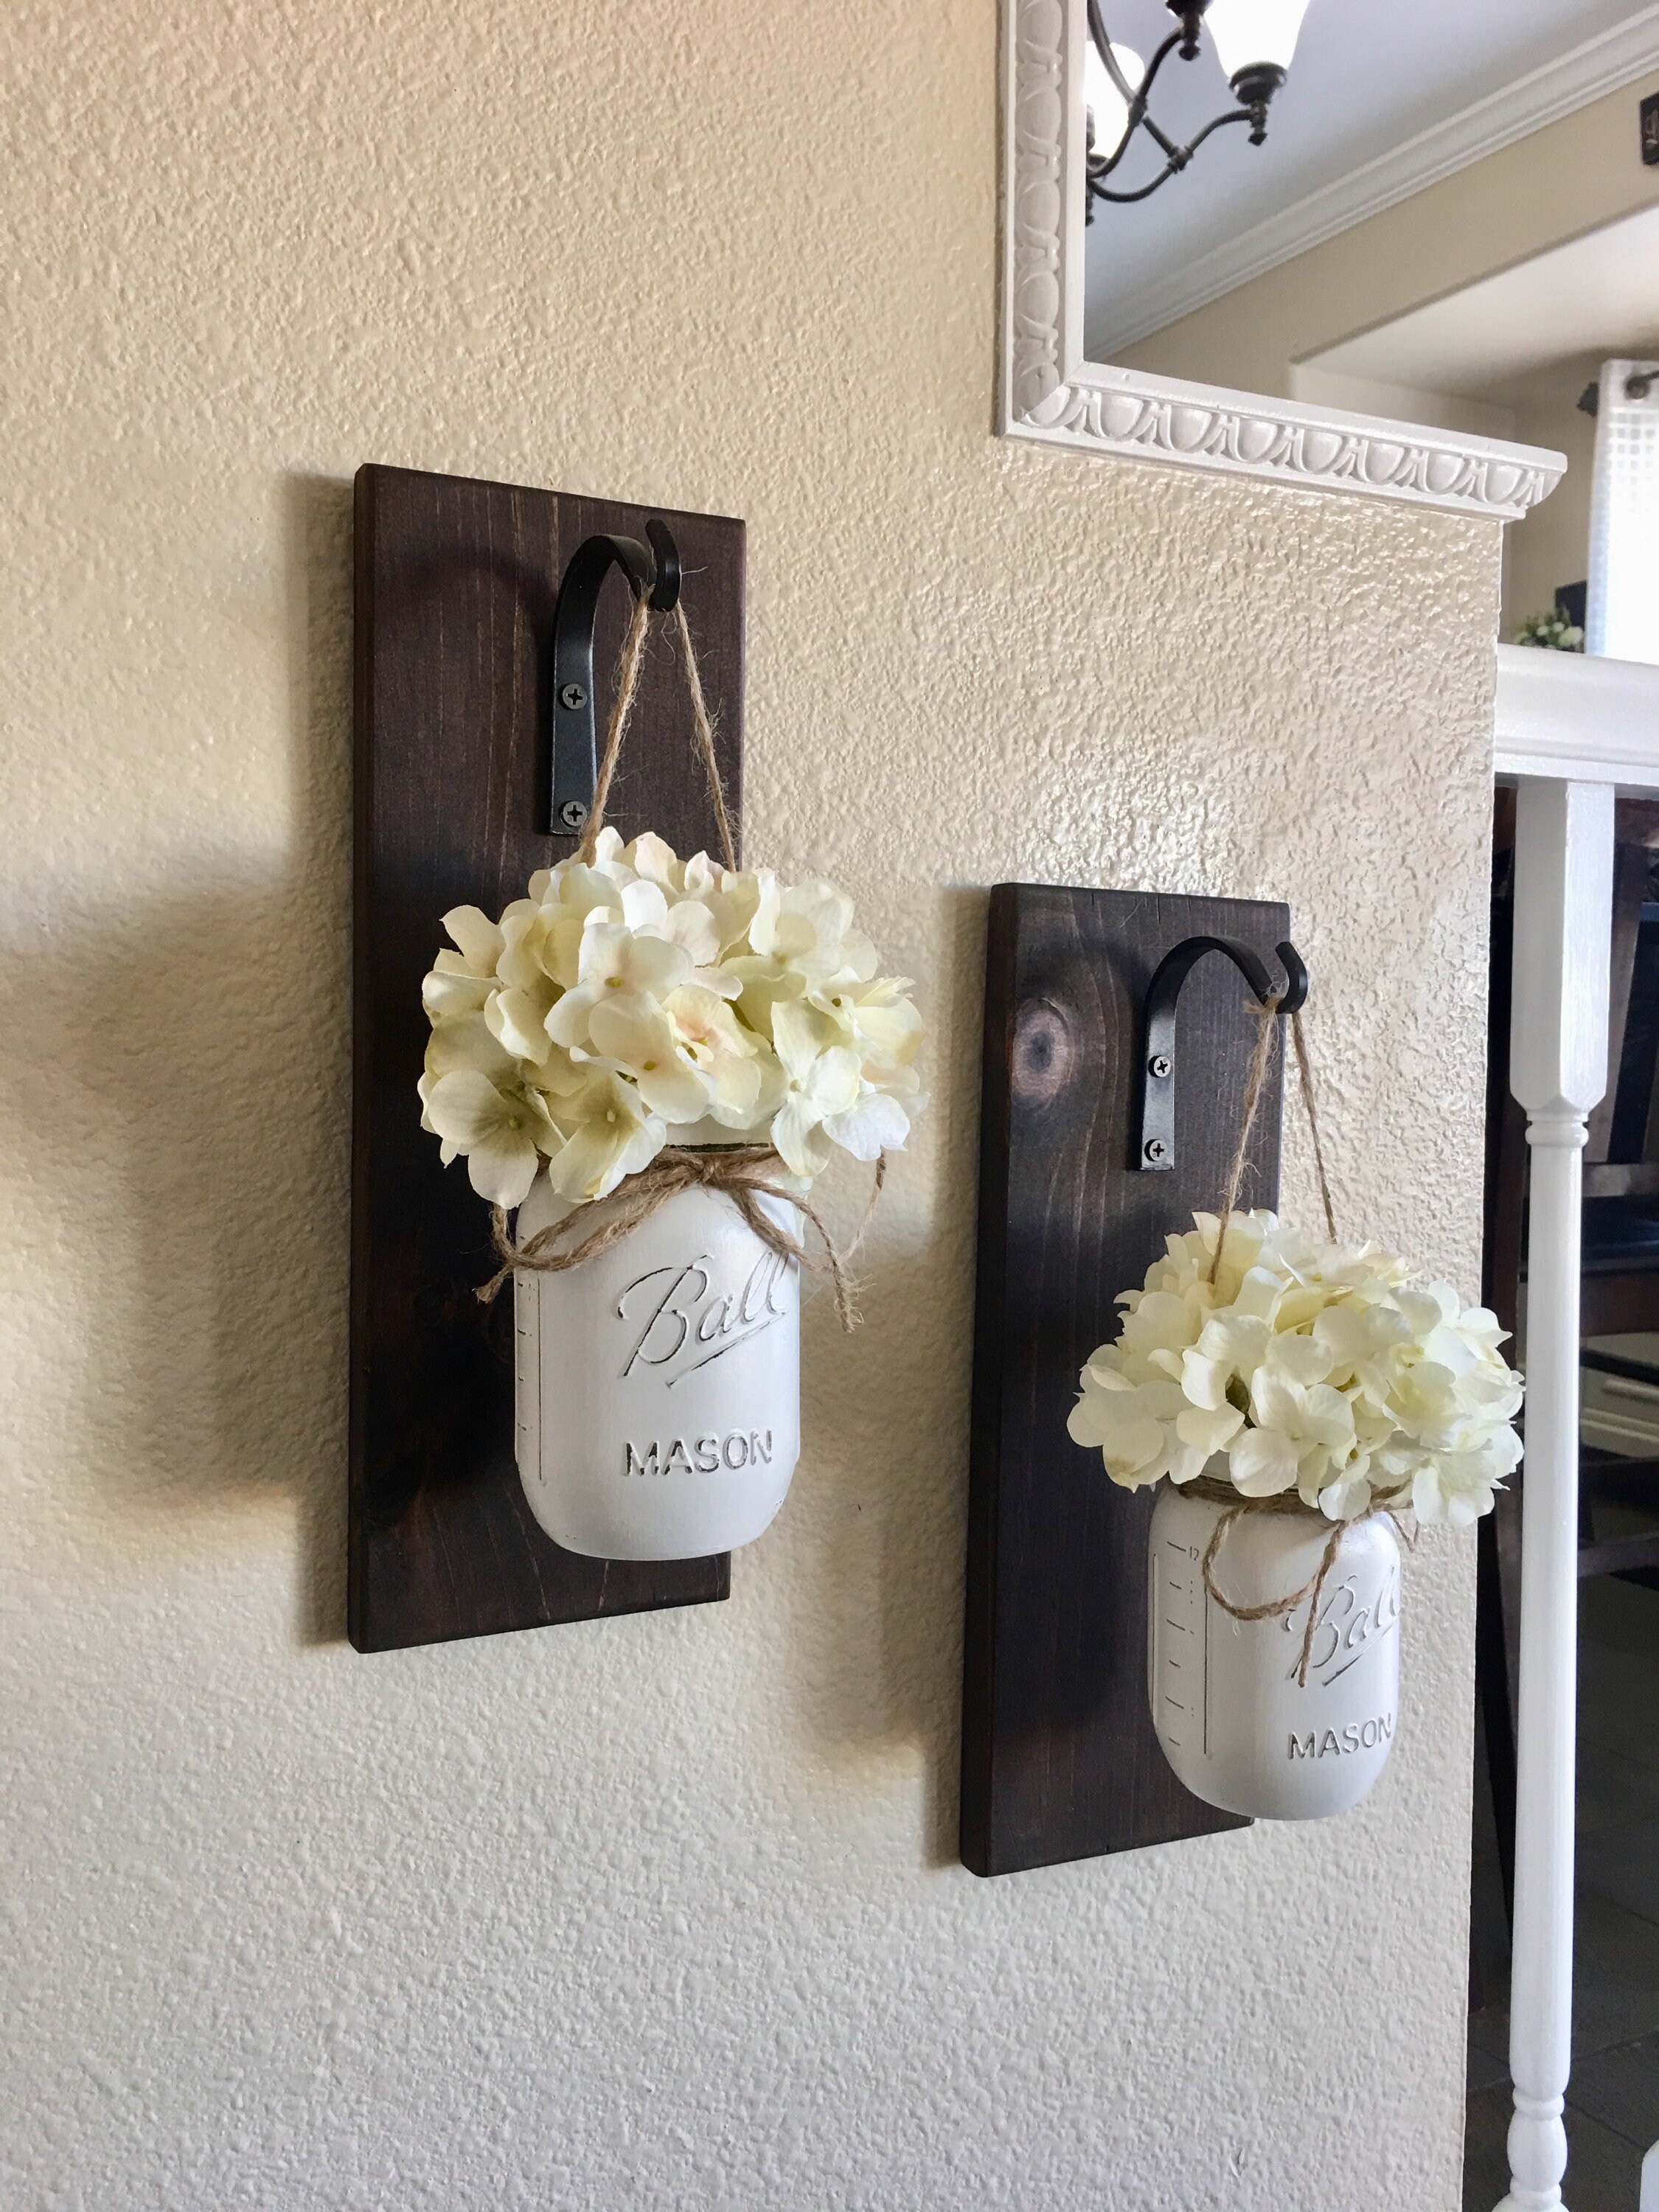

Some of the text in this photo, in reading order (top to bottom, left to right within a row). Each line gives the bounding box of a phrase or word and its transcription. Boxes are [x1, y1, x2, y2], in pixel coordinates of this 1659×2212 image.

[616, 1250, 789, 1379] Ball
[625, 1428, 773, 1478] MASON
[1283, 1566, 1400, 1680] Ball
[1287, 1711, 1392, 1760] MASON
